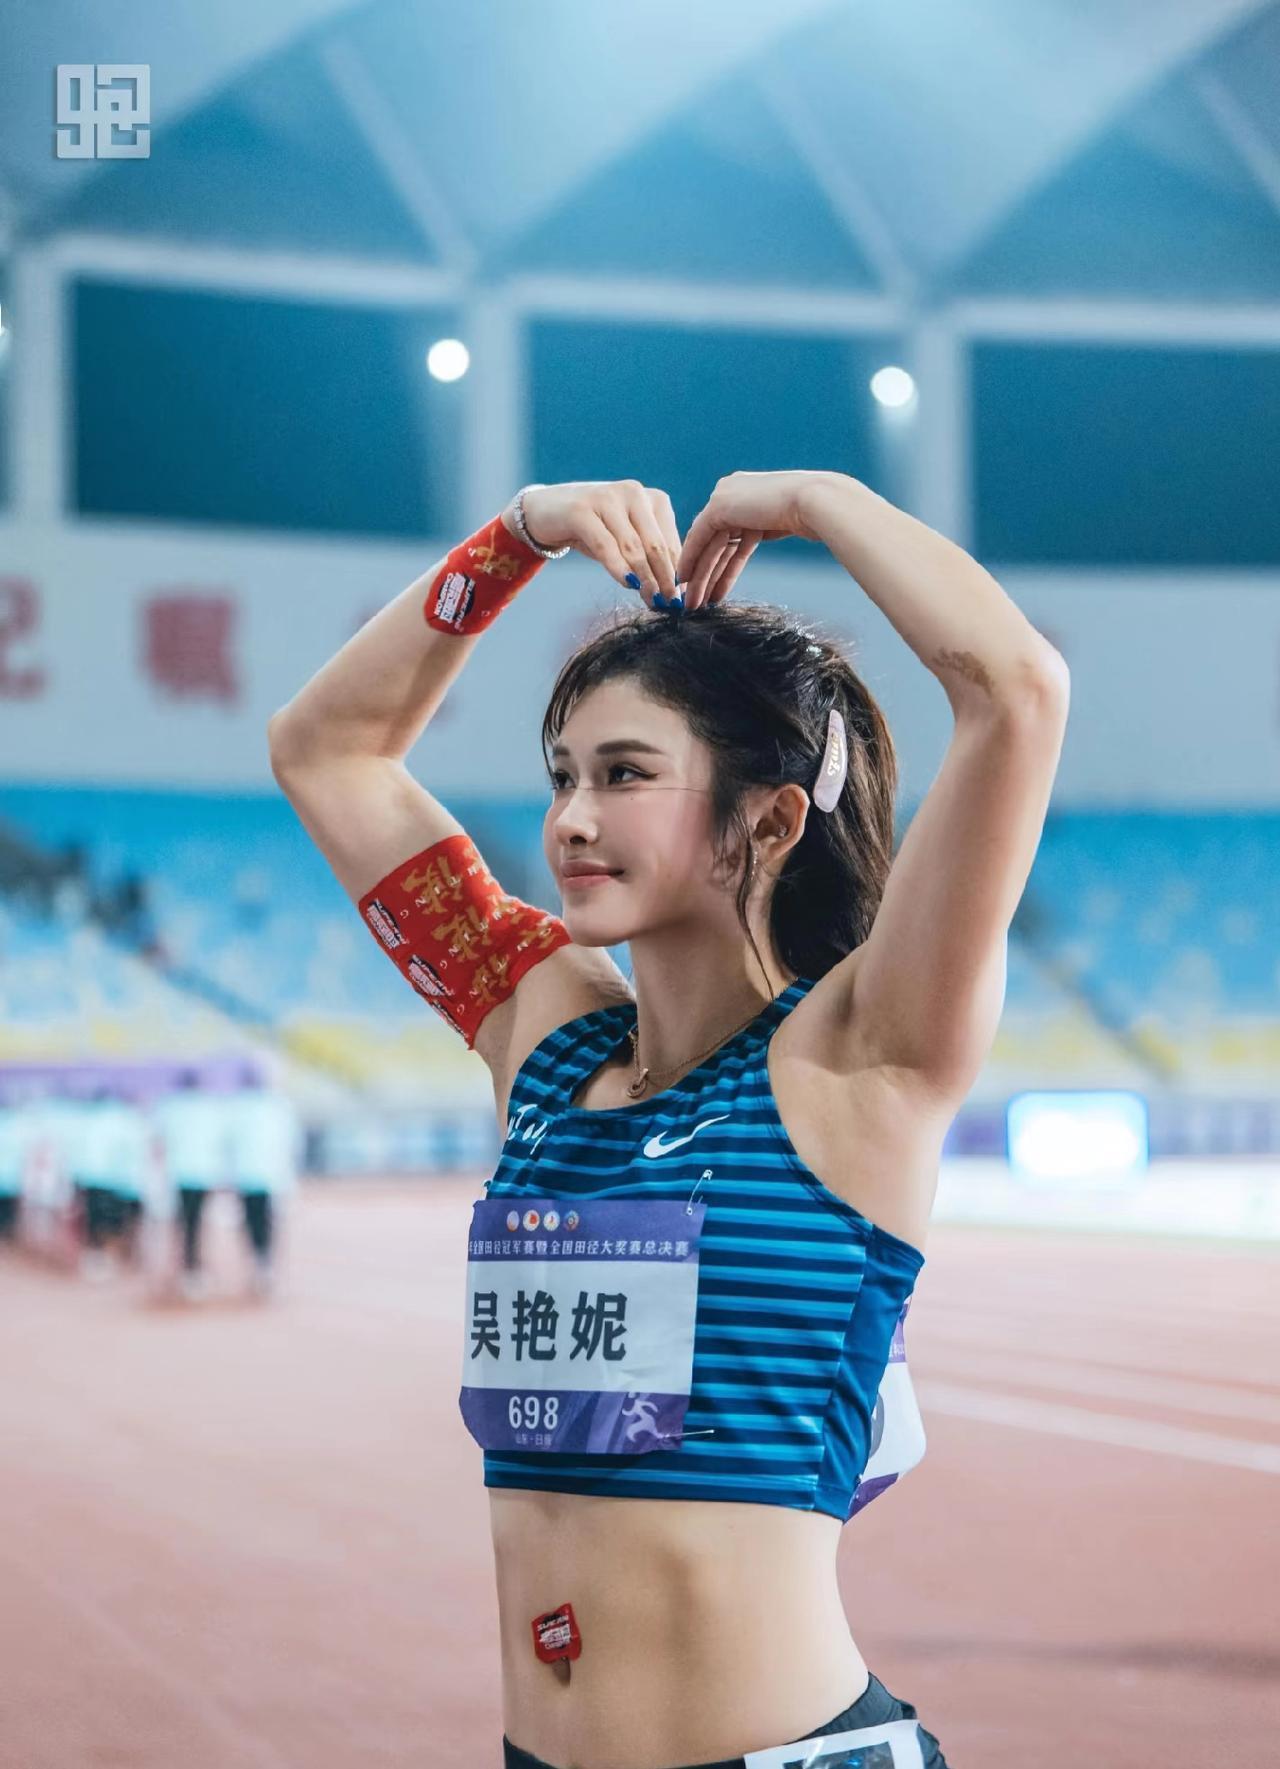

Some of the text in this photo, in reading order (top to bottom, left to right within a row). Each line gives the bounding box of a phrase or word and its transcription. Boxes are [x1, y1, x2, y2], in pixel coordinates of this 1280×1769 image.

[470, 1290, 628, 1362] 吴艳妮
[508, 1396, 560, 1430] 698
